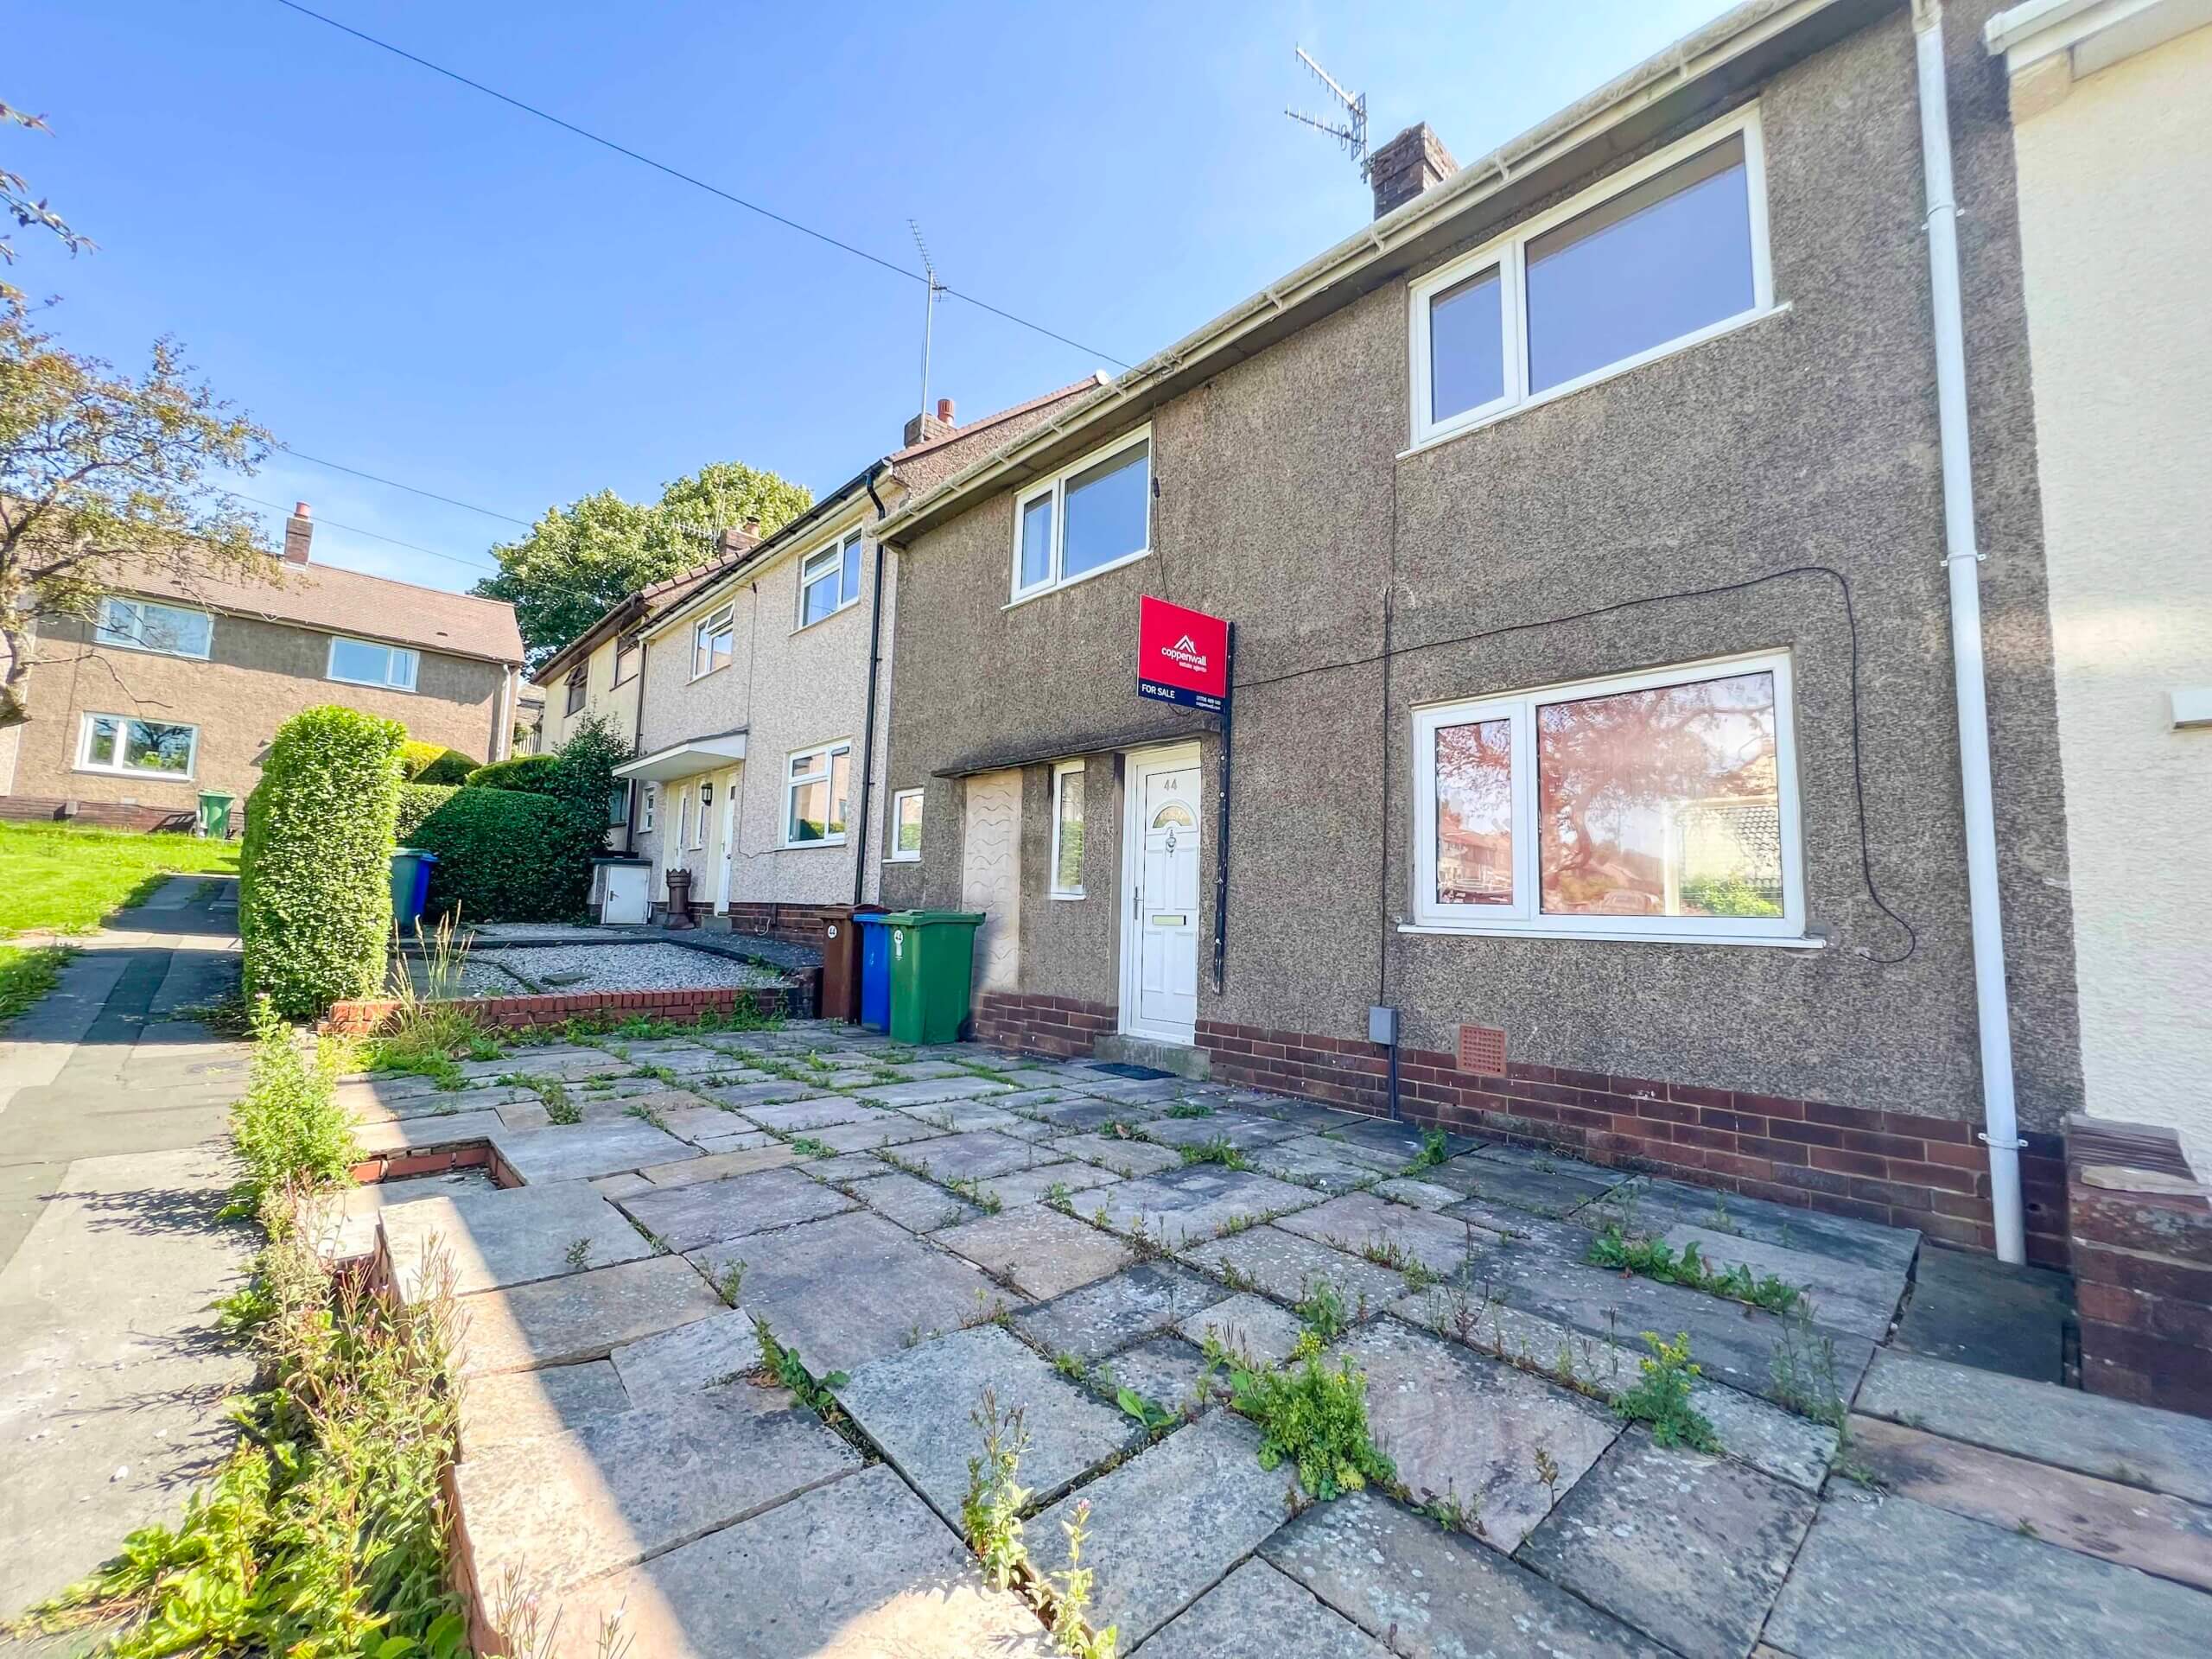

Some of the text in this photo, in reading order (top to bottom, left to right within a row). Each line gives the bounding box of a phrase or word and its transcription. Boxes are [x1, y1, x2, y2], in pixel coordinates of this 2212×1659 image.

[1141, 683, 1175, 699] FOR SALE
[1163, 779, 1178, 791] 44
